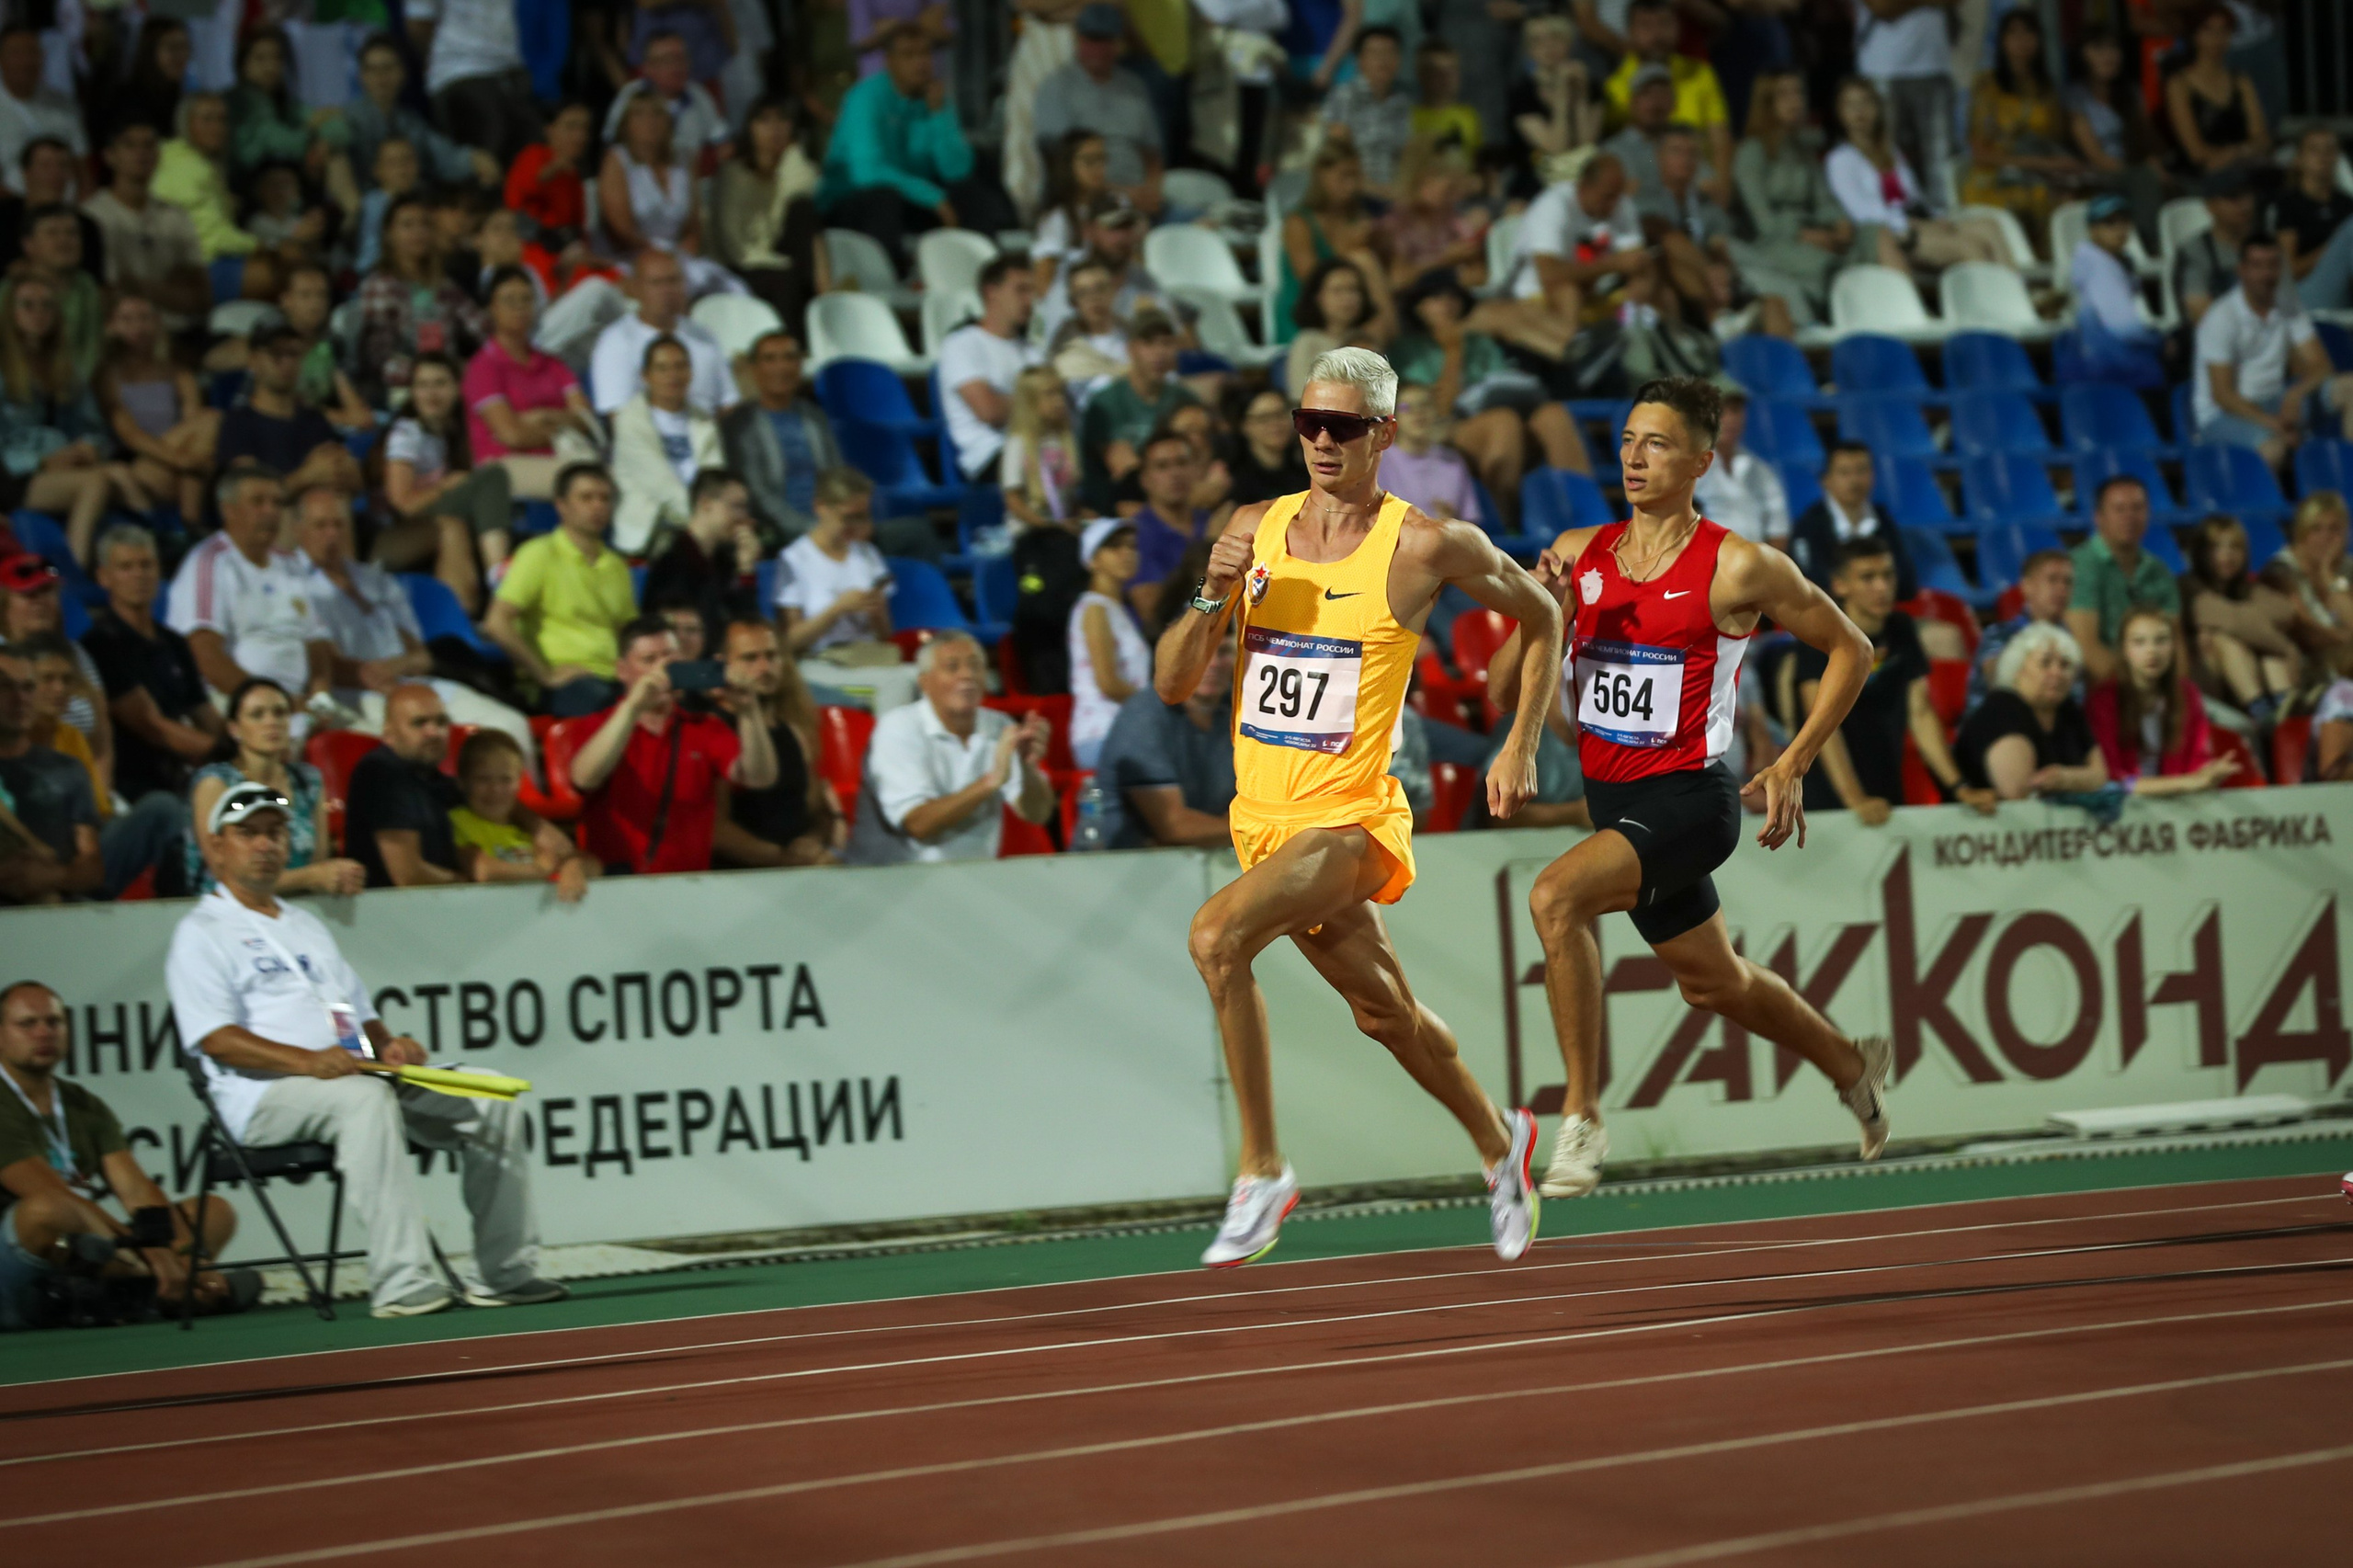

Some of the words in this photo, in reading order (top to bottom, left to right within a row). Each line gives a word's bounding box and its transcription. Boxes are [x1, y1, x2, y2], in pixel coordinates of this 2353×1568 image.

[1266, 636, 1314, 650] ЧЕМПИОНАТ
[1316, 642, 1355, 654] РОССИИ
[1643, 652, 1677, 662] РОССИИ
[1258, 665, 1330, 721] 297
[1593, 669, 1654, 722] 564
[1935, 823, 2177, 869] КОНДИТЕРСКАЯ
[2188, 814, 2332, 851] ФАБРИКА
[568, 962, 828, 1042] СПОРТА
[524, 1074, 905, 1178] ЕДЕРАЦИИ
